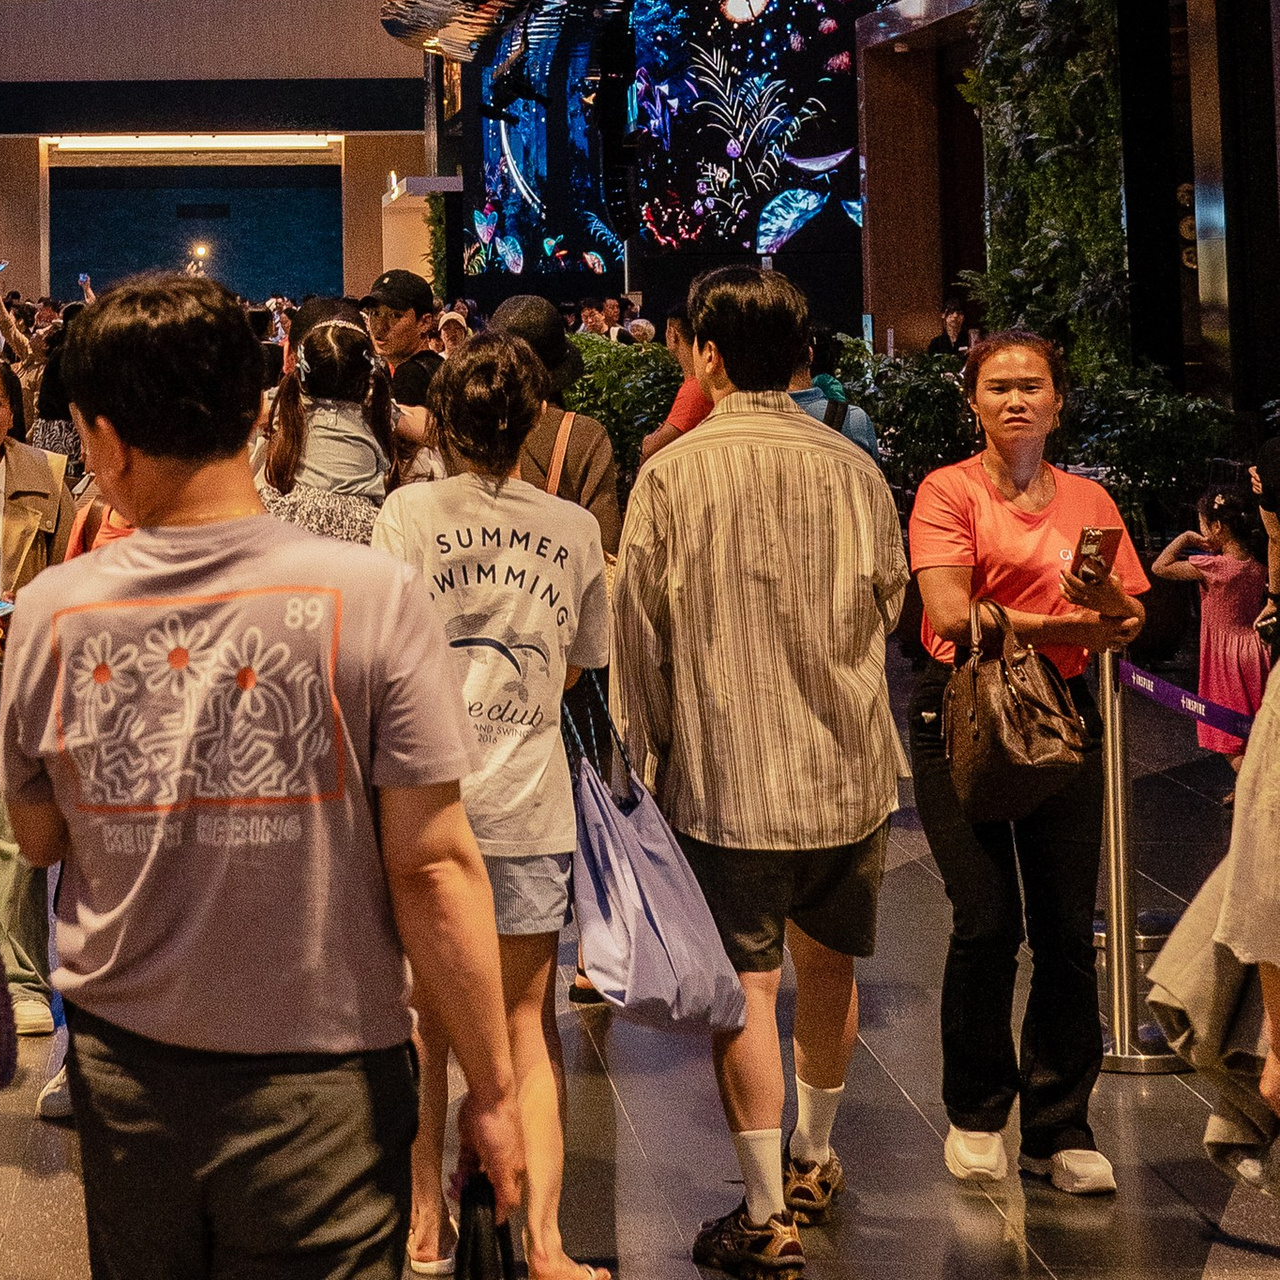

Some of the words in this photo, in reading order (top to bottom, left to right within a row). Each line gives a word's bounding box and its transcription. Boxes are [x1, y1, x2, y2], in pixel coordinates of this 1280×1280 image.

[436, 527, 569, 570] SUMMER
[430, 563, 569, 627] WIMMING
[284, 597, 324, 630] 89
[1135, 673, 1154, 692] INSPIRE
[487, 699, 544, 728] club
[1185, 697, 1205, 716] INSPIRE
[477, 732, 498, 744] 2016
